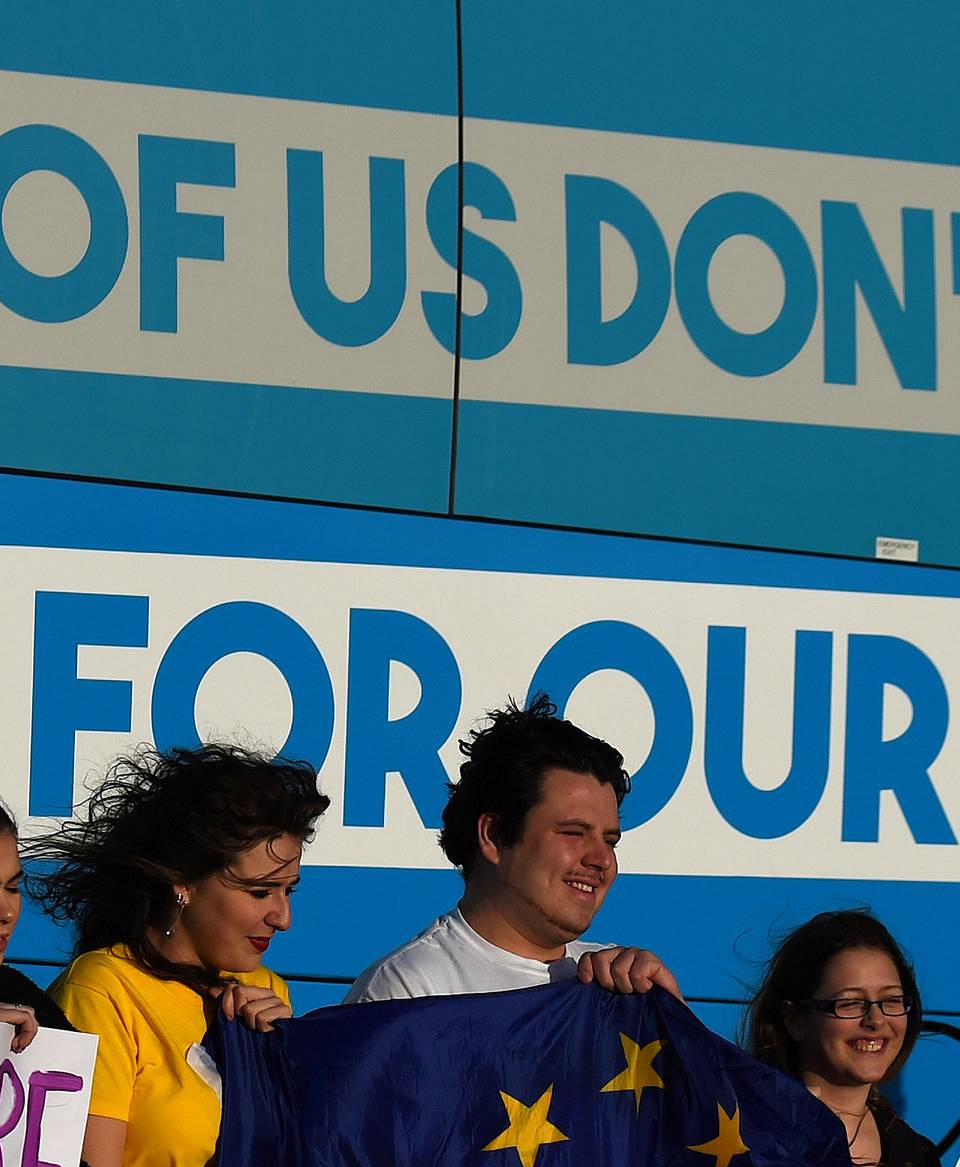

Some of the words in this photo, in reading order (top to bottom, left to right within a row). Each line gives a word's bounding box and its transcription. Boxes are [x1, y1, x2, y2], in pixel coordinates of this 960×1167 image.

[286, 148, 523, 360] US
[28, 590, 463, 829] FOR
[526, 619, 959, 846] OUR
